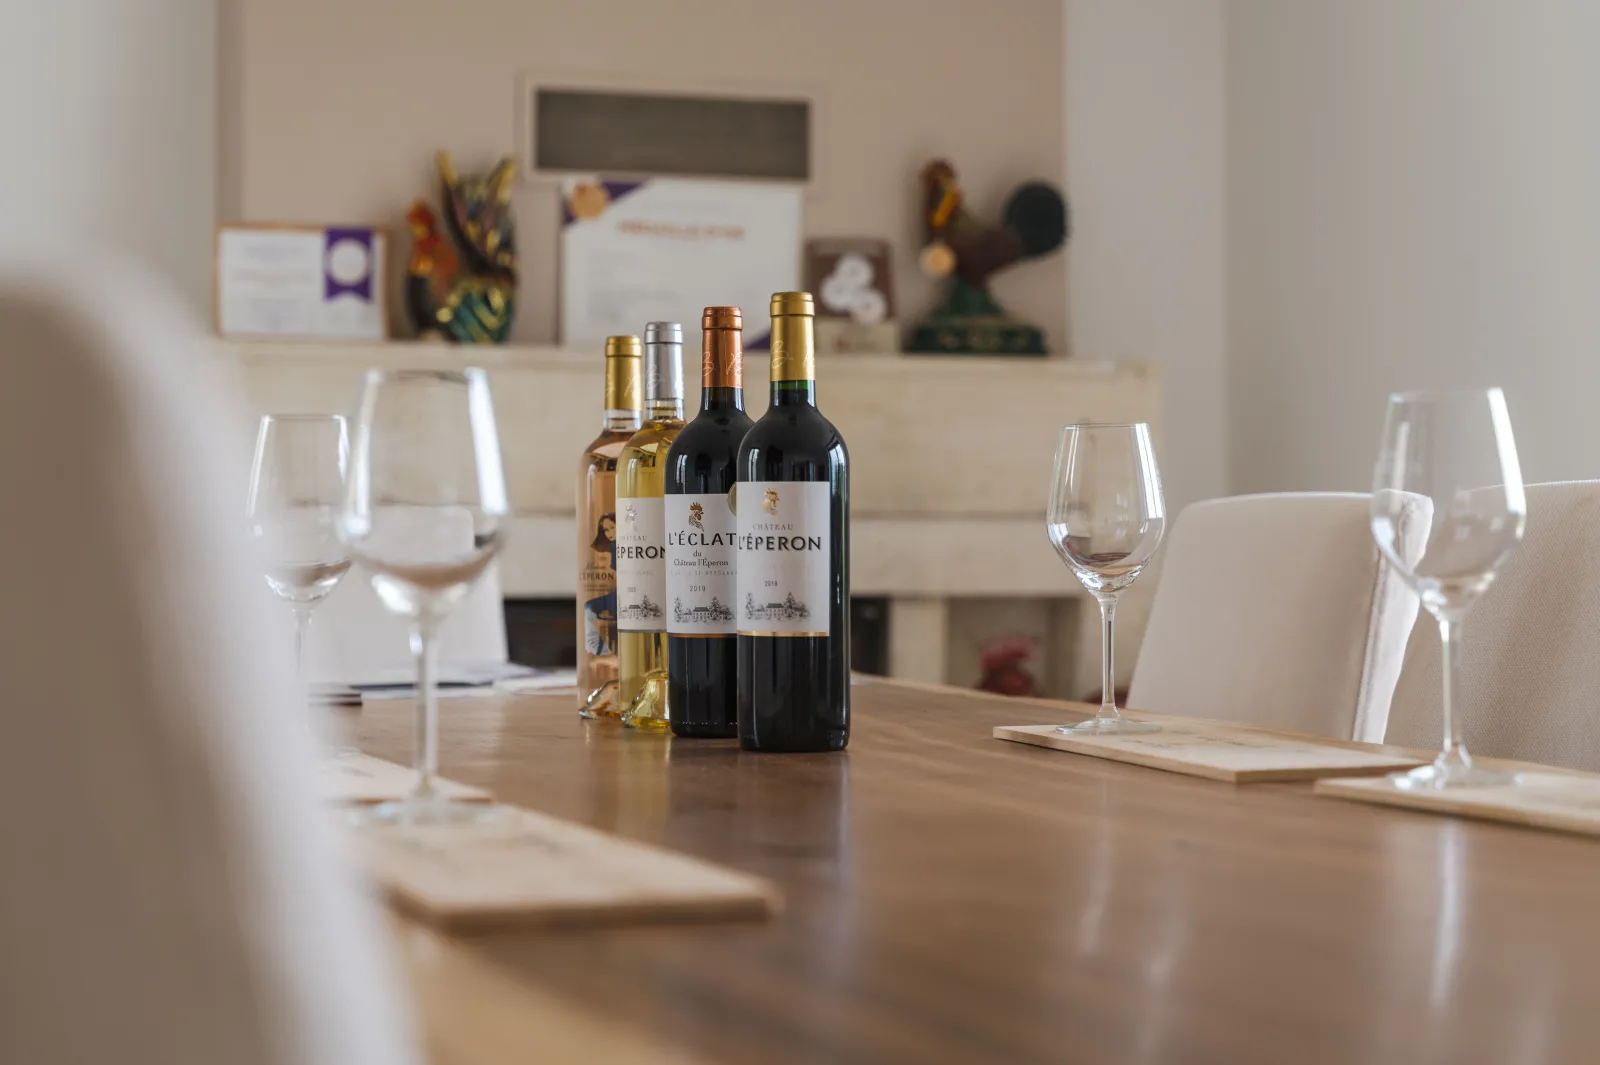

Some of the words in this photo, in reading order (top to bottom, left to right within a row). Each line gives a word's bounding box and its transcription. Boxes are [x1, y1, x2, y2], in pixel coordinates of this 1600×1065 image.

[668, 530, 737, 546] L'ÉCLAT
[738, 533, 822, 551] L'ÉPERON
[693, 549, 702, 557] du
